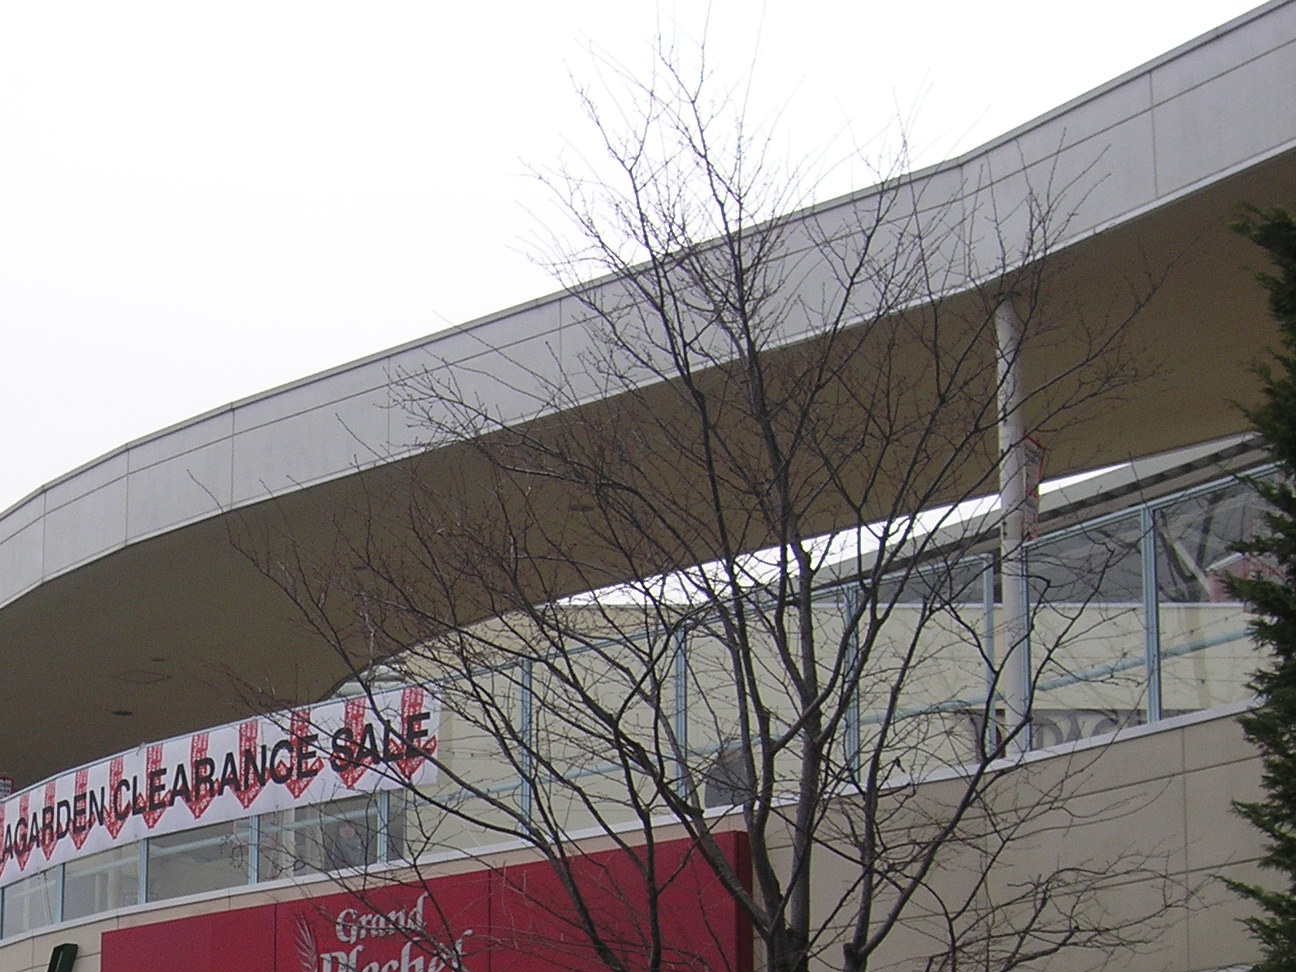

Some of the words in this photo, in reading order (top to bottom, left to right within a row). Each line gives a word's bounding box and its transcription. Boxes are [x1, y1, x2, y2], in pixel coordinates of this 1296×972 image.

[113, 734, 319, 821] CLEARANCE
[330, 711, 432, 773] SALE
[335, 891, 429, 944] Grand
